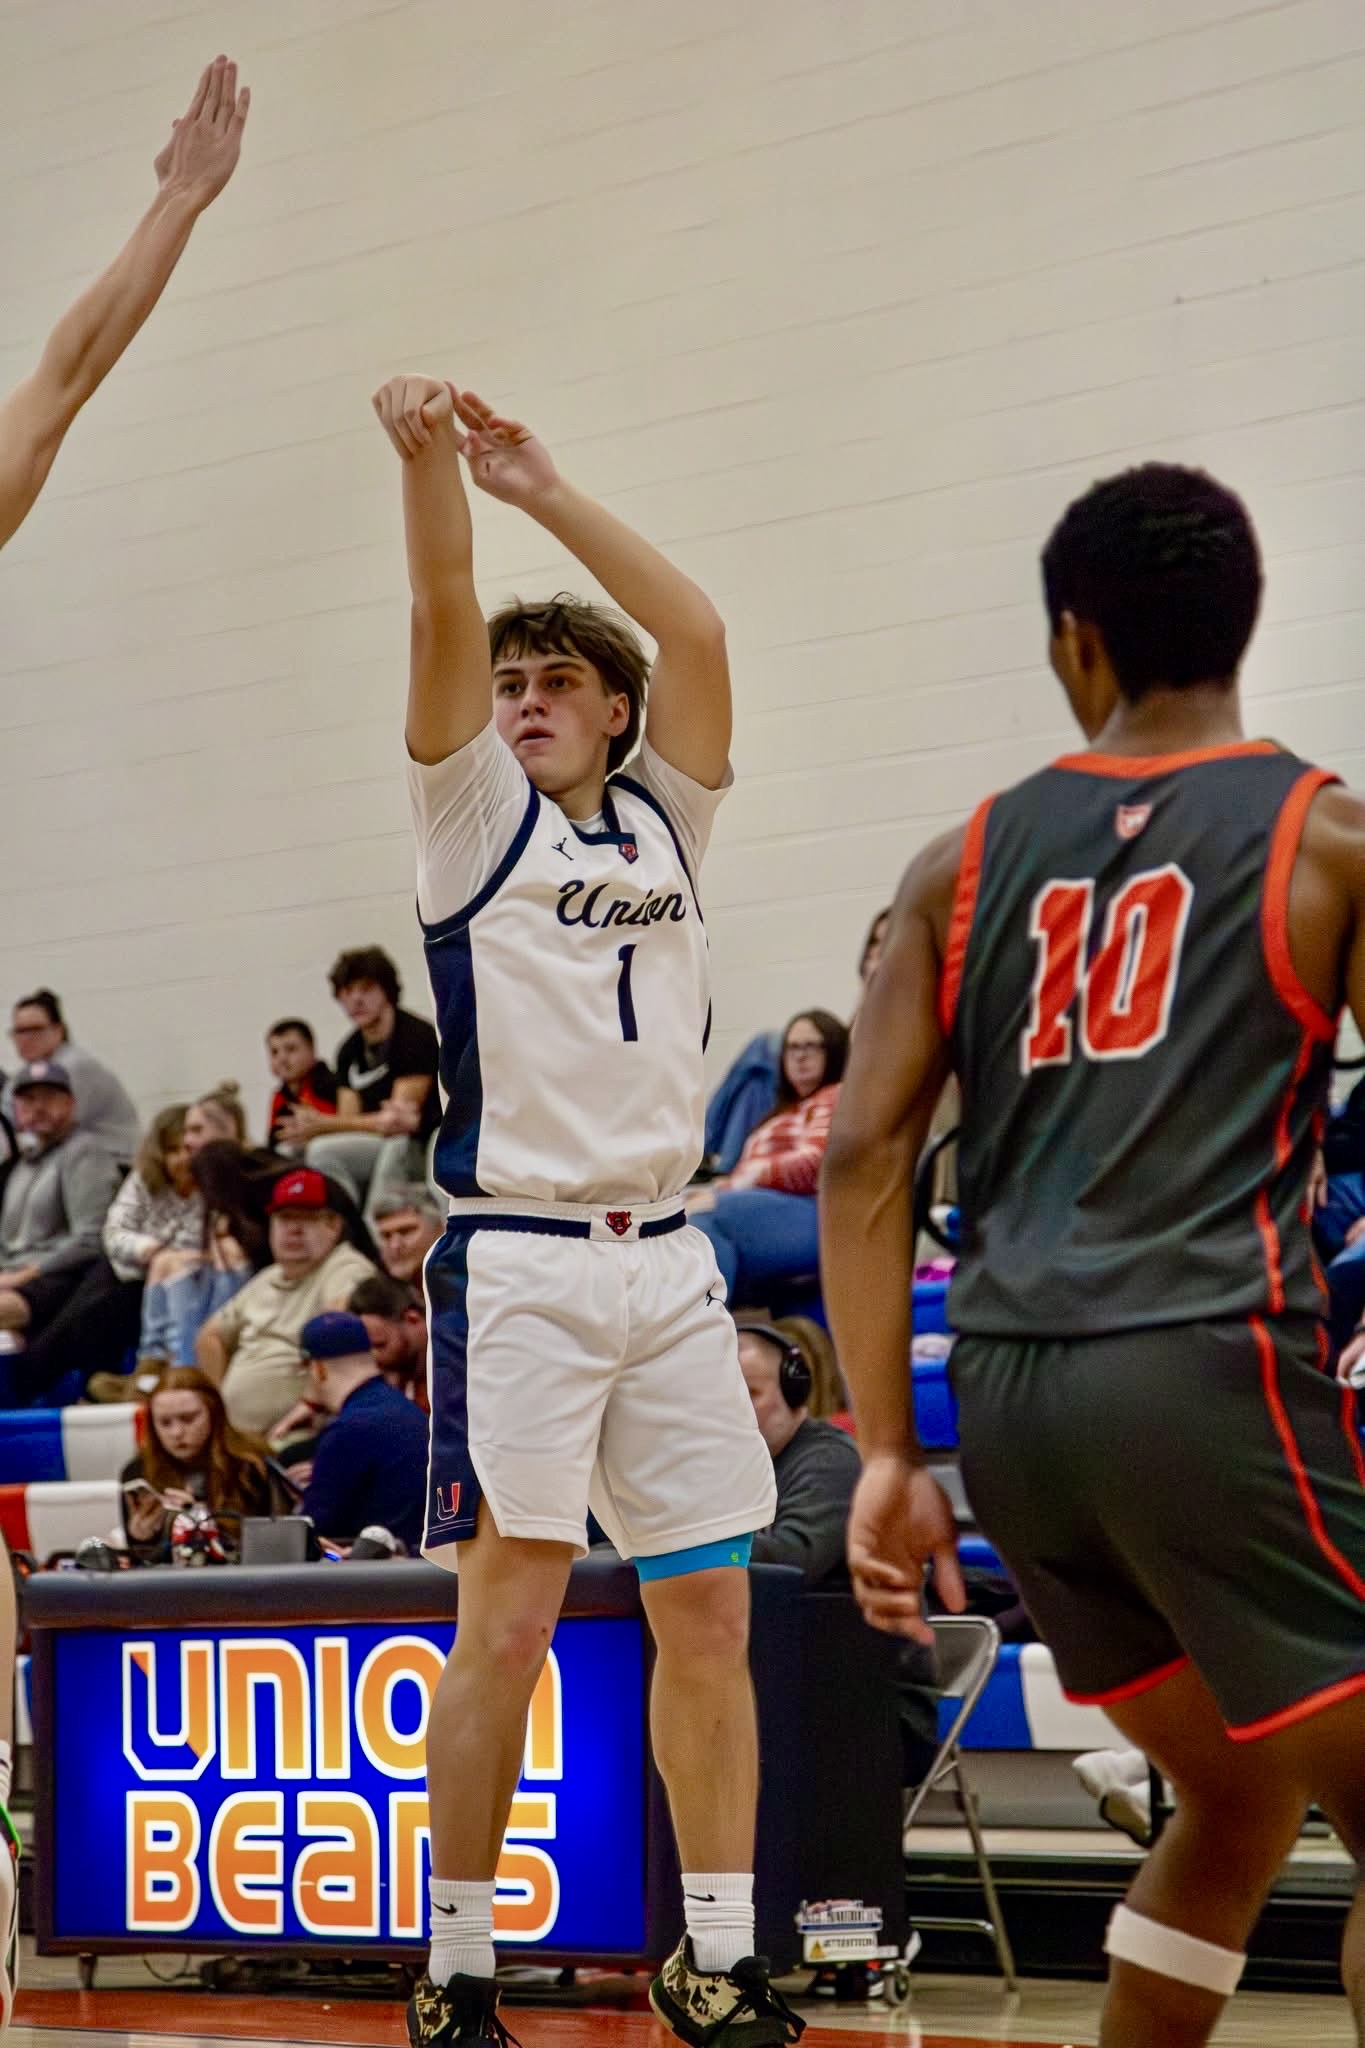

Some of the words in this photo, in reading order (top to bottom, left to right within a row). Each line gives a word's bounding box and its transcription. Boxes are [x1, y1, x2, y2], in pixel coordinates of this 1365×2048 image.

[556, 879, 686, 928] Union
[617, 943, 638, 1042] 1
[1021, 862, 1195, 1076] 10
[436, 1482, 461, 1520] U
